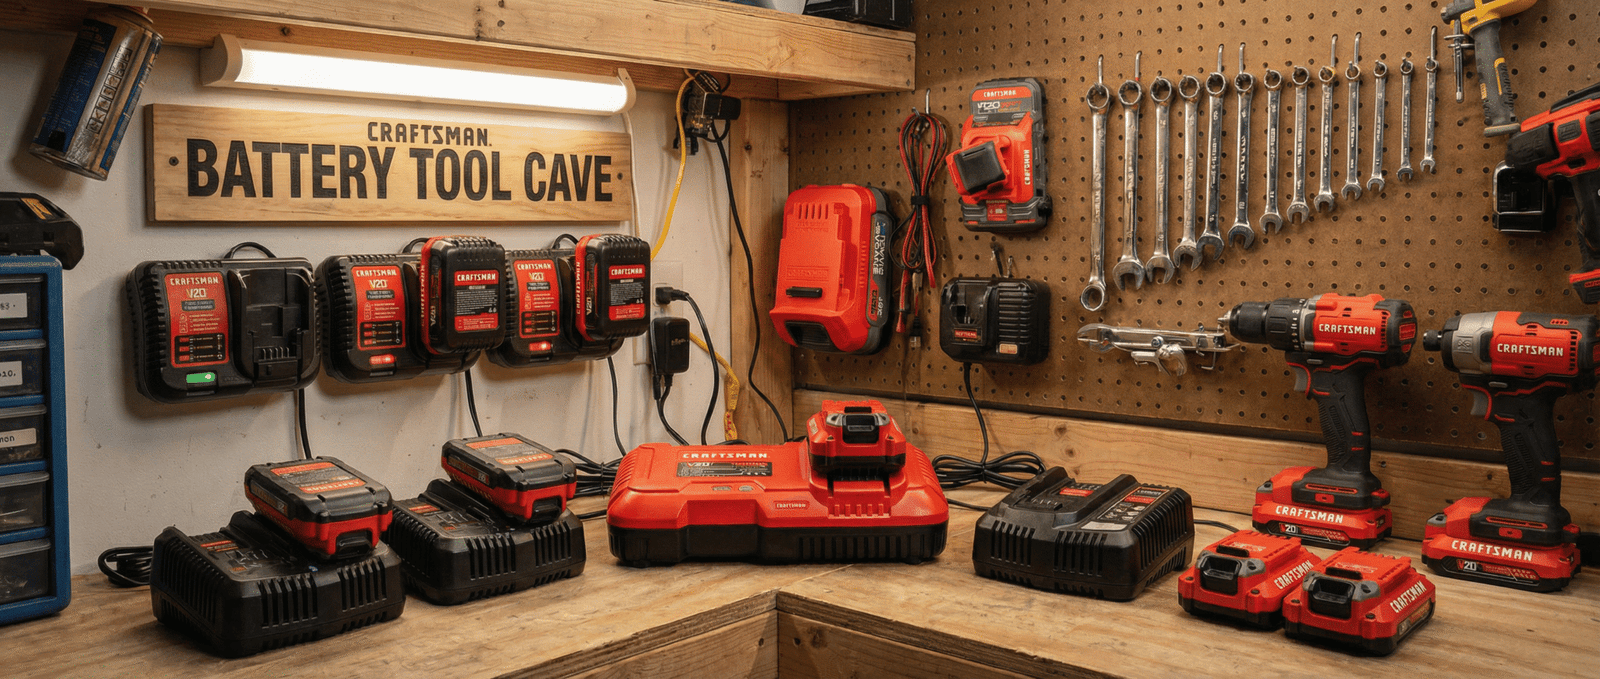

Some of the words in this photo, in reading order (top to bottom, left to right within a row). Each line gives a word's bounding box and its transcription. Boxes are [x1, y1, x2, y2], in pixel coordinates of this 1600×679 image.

[187, 138, 396, 200] BATTERY
[409, 147, 512, 201] TOOL
[524, 151, 613, 202] CAVE
[355, 268, 397, 277] CRAFTSMAN
[457, 273, 496, 282] CRAFTSMAN
[170, 276, 219, 286] CRAFTSMAN
[1319, 323, 1376, 335] CRAFTSMAN
[1497, 343, 1564, 356] CRAFTSMAN
[1275, 505, 1344, 524] CRAFTSMAN
[1451, 540, 1533, 561] CRAFTSMAN
[1457, 559, 1477, 571] V20
[1273, 559, 1315, 590] CRAFTSMAN
[1390, 580, 1427, 613] CRAFTSMAN
